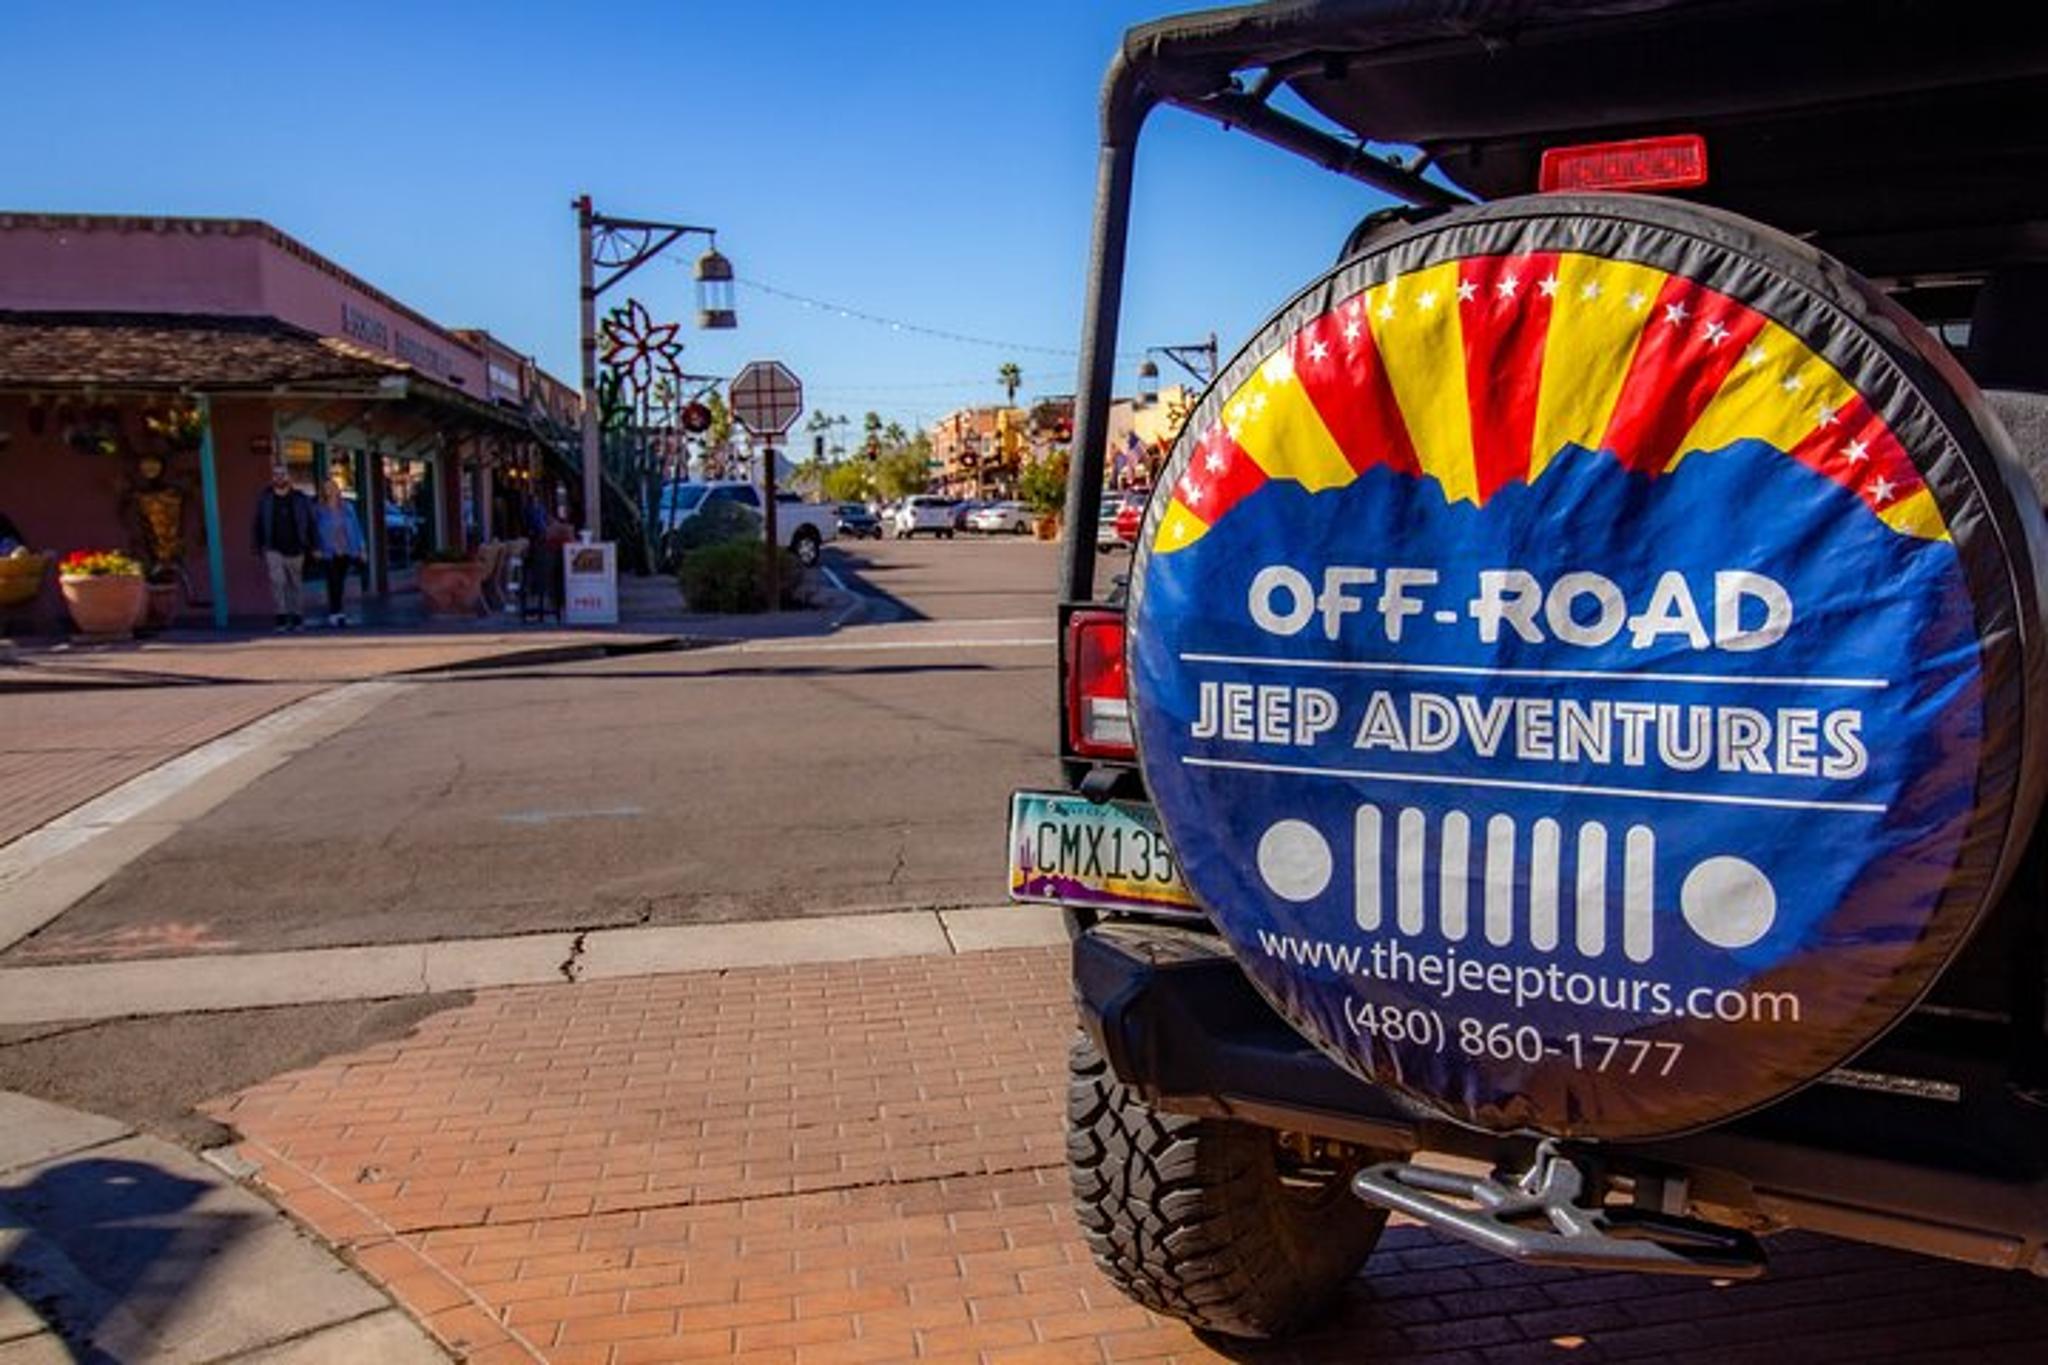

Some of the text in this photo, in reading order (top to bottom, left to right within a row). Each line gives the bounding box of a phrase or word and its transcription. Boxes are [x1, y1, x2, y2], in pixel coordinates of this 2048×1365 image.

[1248, 565, 1793, 651] OFF-ROAD
[1191, 681, 1868, 780] JEEP ADVENTURES
[1257, 929, 1800, 1023] www.thejeeptours.com
[1344, 996, 1684, 1077] (480) 860-1777
